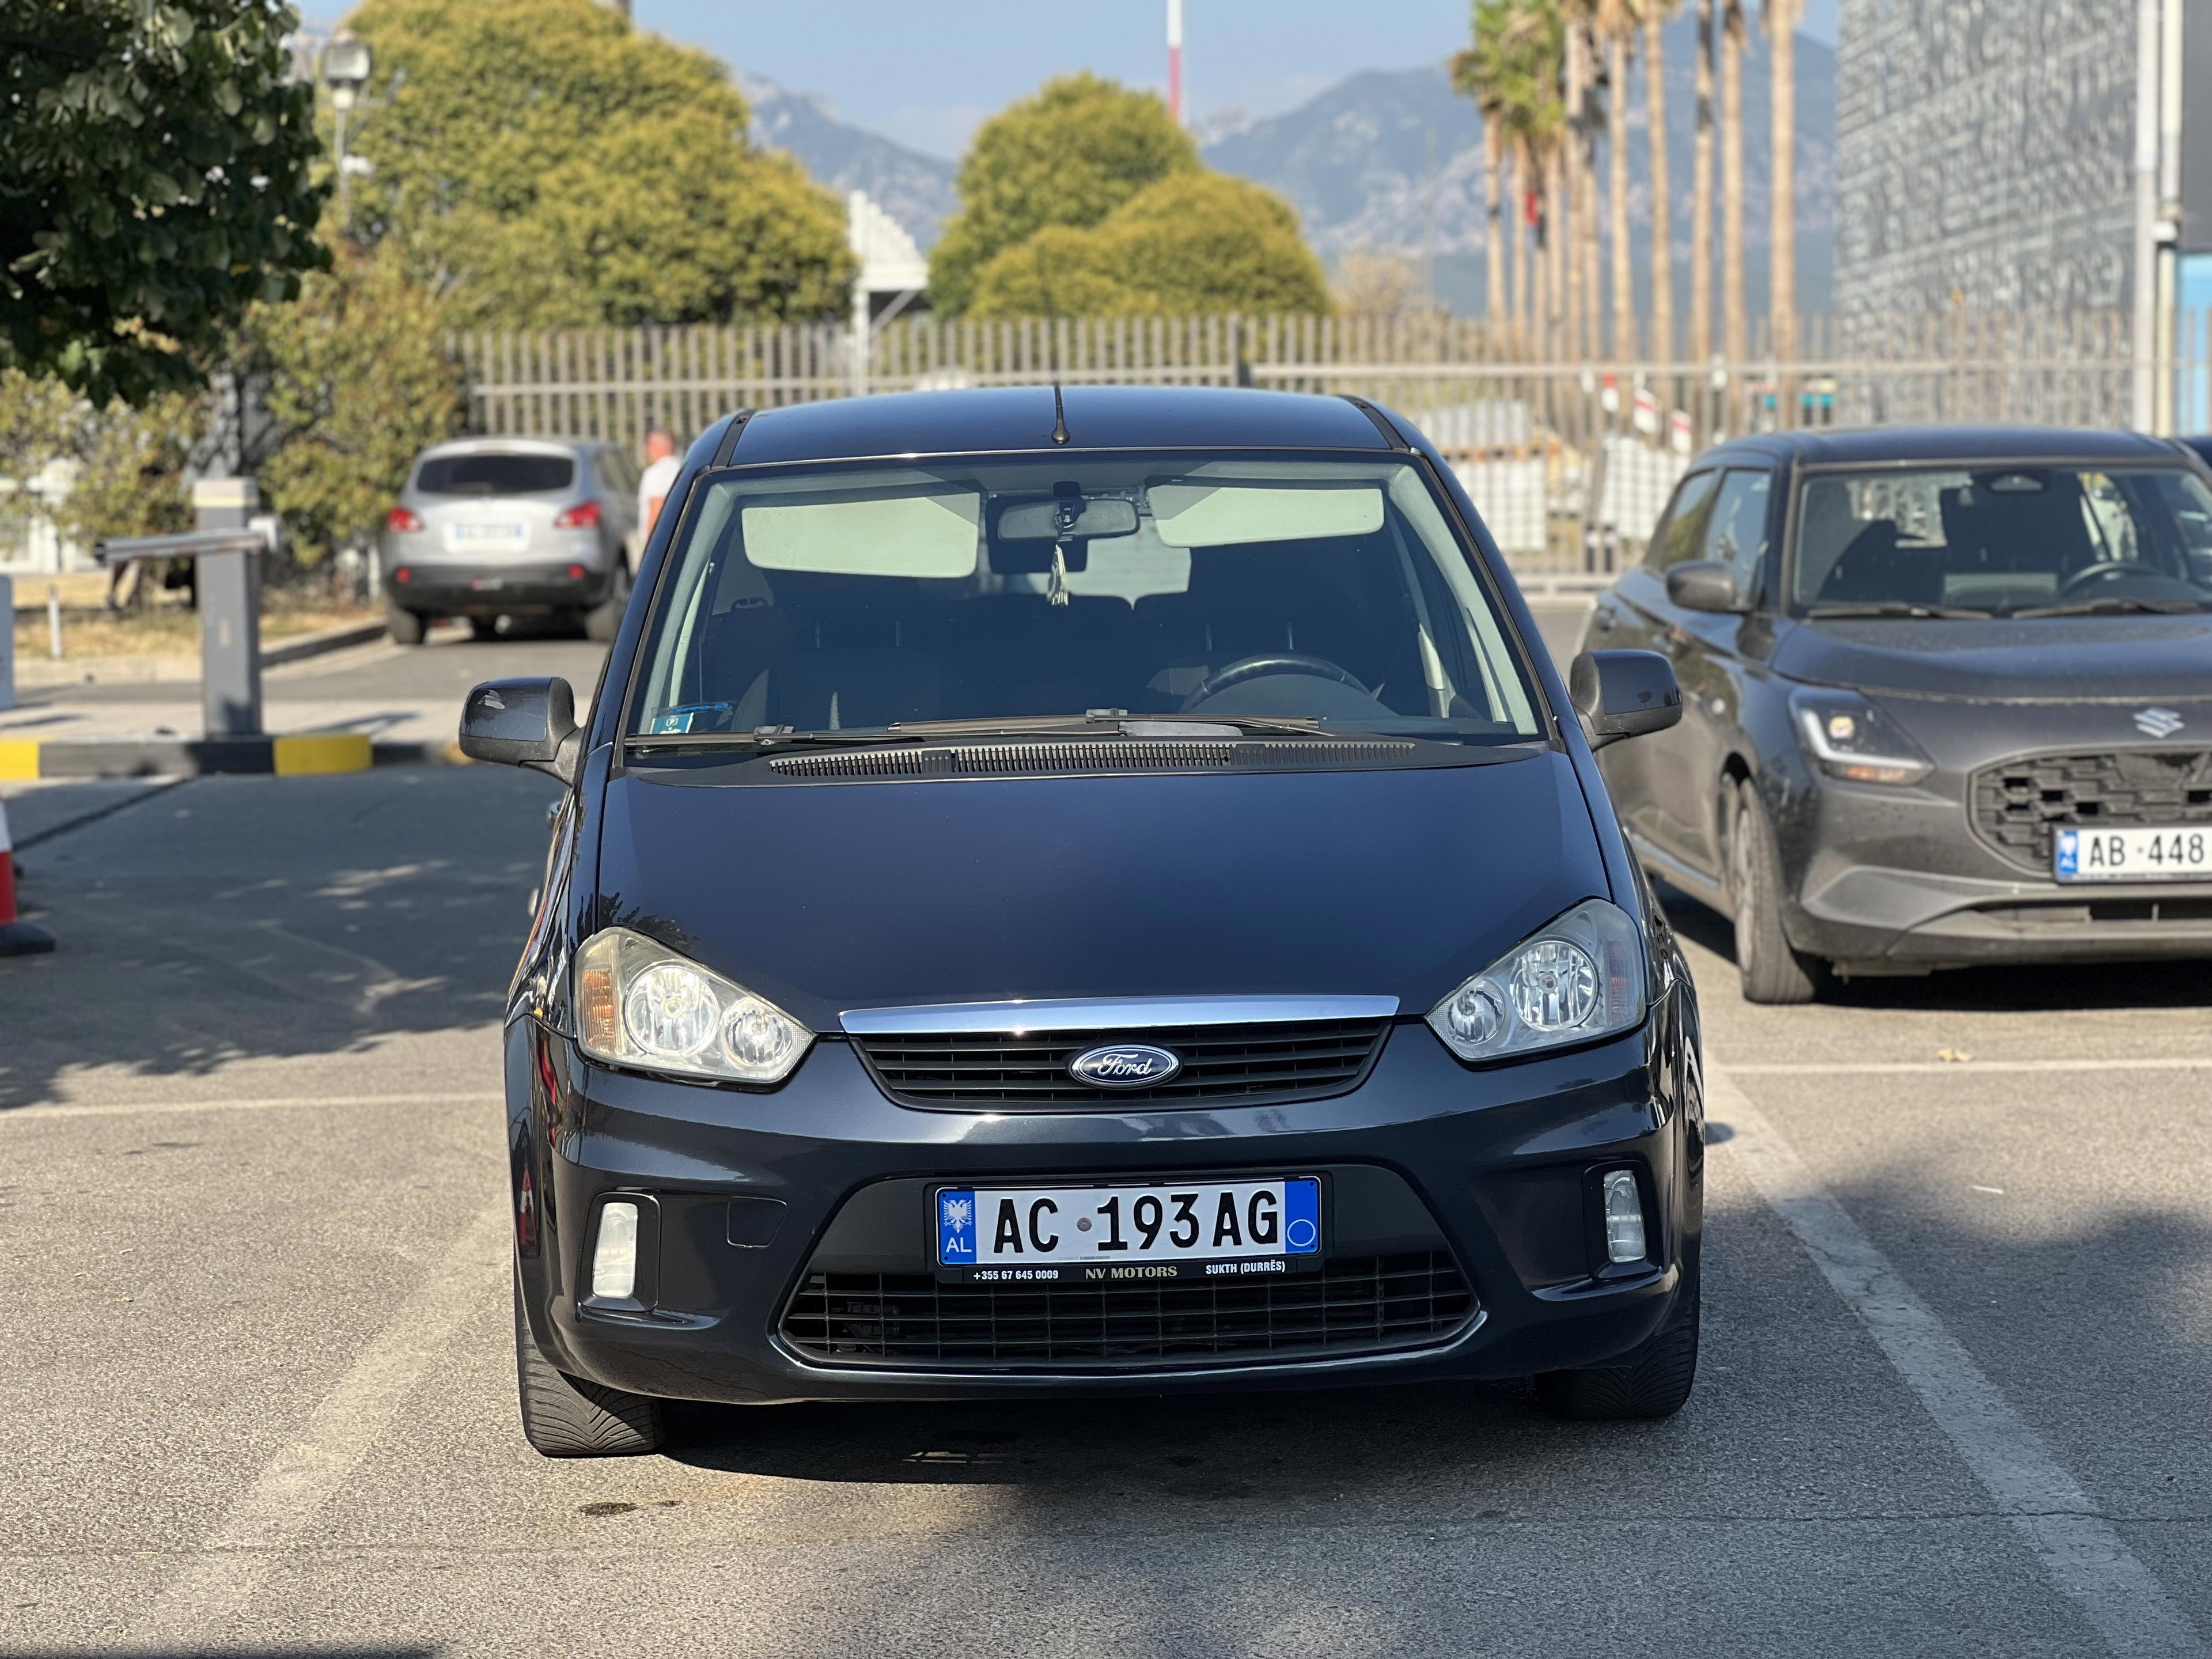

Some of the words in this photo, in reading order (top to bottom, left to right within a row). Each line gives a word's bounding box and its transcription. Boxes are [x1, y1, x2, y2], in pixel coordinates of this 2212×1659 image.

[2090, 836, 2126, 867] AB
[2148, 834, 2205, 865] 448
[1097, 1053, 1153, 1077] Ford
[993, 1198, 1059, 1254] AC
[945, 1237, 972, 1253] AL
[1085, 1268, 1107, 1279] NV
[1111, 1266, 1178, 1279] MOTORS
[1205, 1263, 1237, 1275] SUKTH
[1240, 1259, 1286, 1275] (DURRËS)
[973, 1270, 999, 1281] +355
[1001, 1270, 1013, 1280] 67
[1015, 1270, 1033, 1280] 645
[1035, 1270, 1059, 1279] 0009
